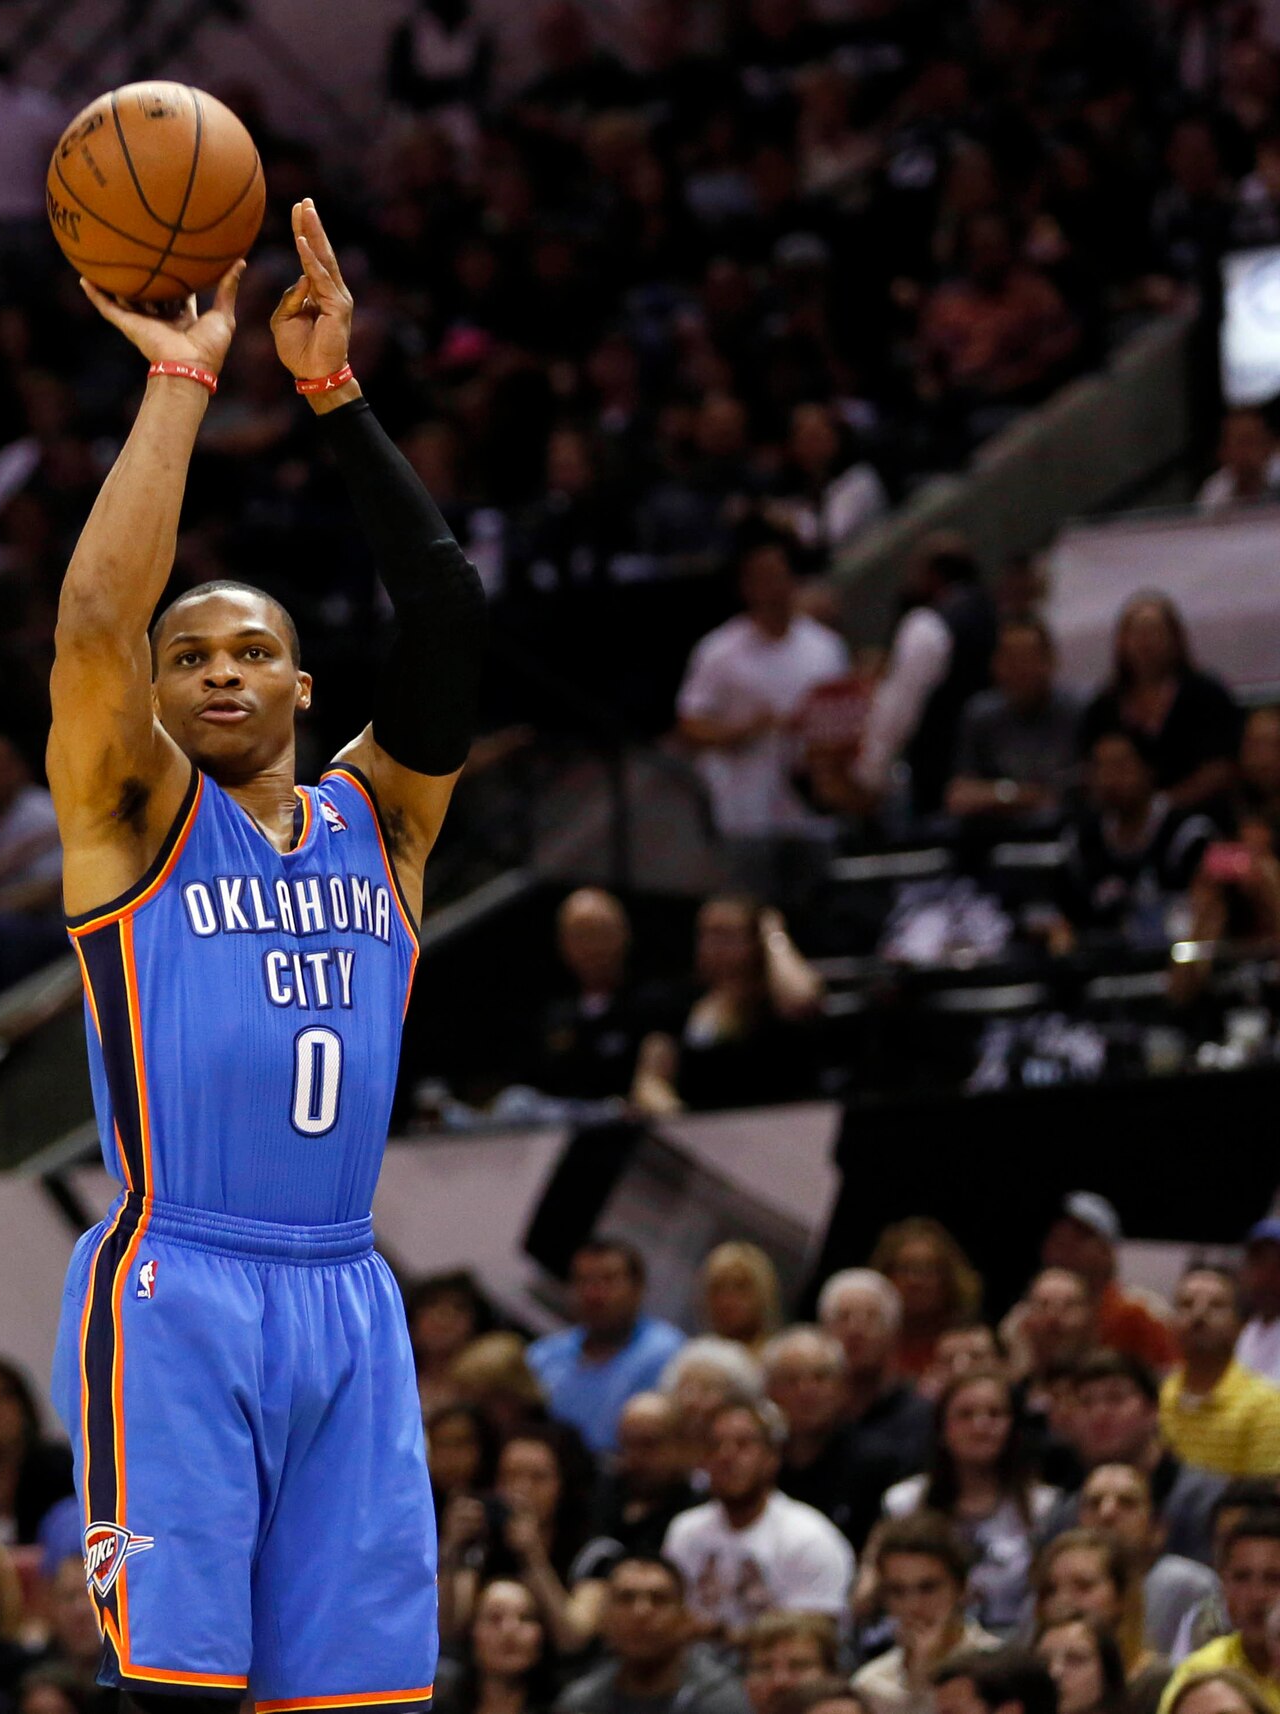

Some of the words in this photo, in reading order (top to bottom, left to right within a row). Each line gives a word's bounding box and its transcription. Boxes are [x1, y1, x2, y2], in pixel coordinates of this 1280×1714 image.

[184, 874, 391, 946] OKLAHOMA
[263, 948, 356, 1010] CITY
[290, 1024, 344, 1138] 0
[86, 1536, 116, 1580] OKC
